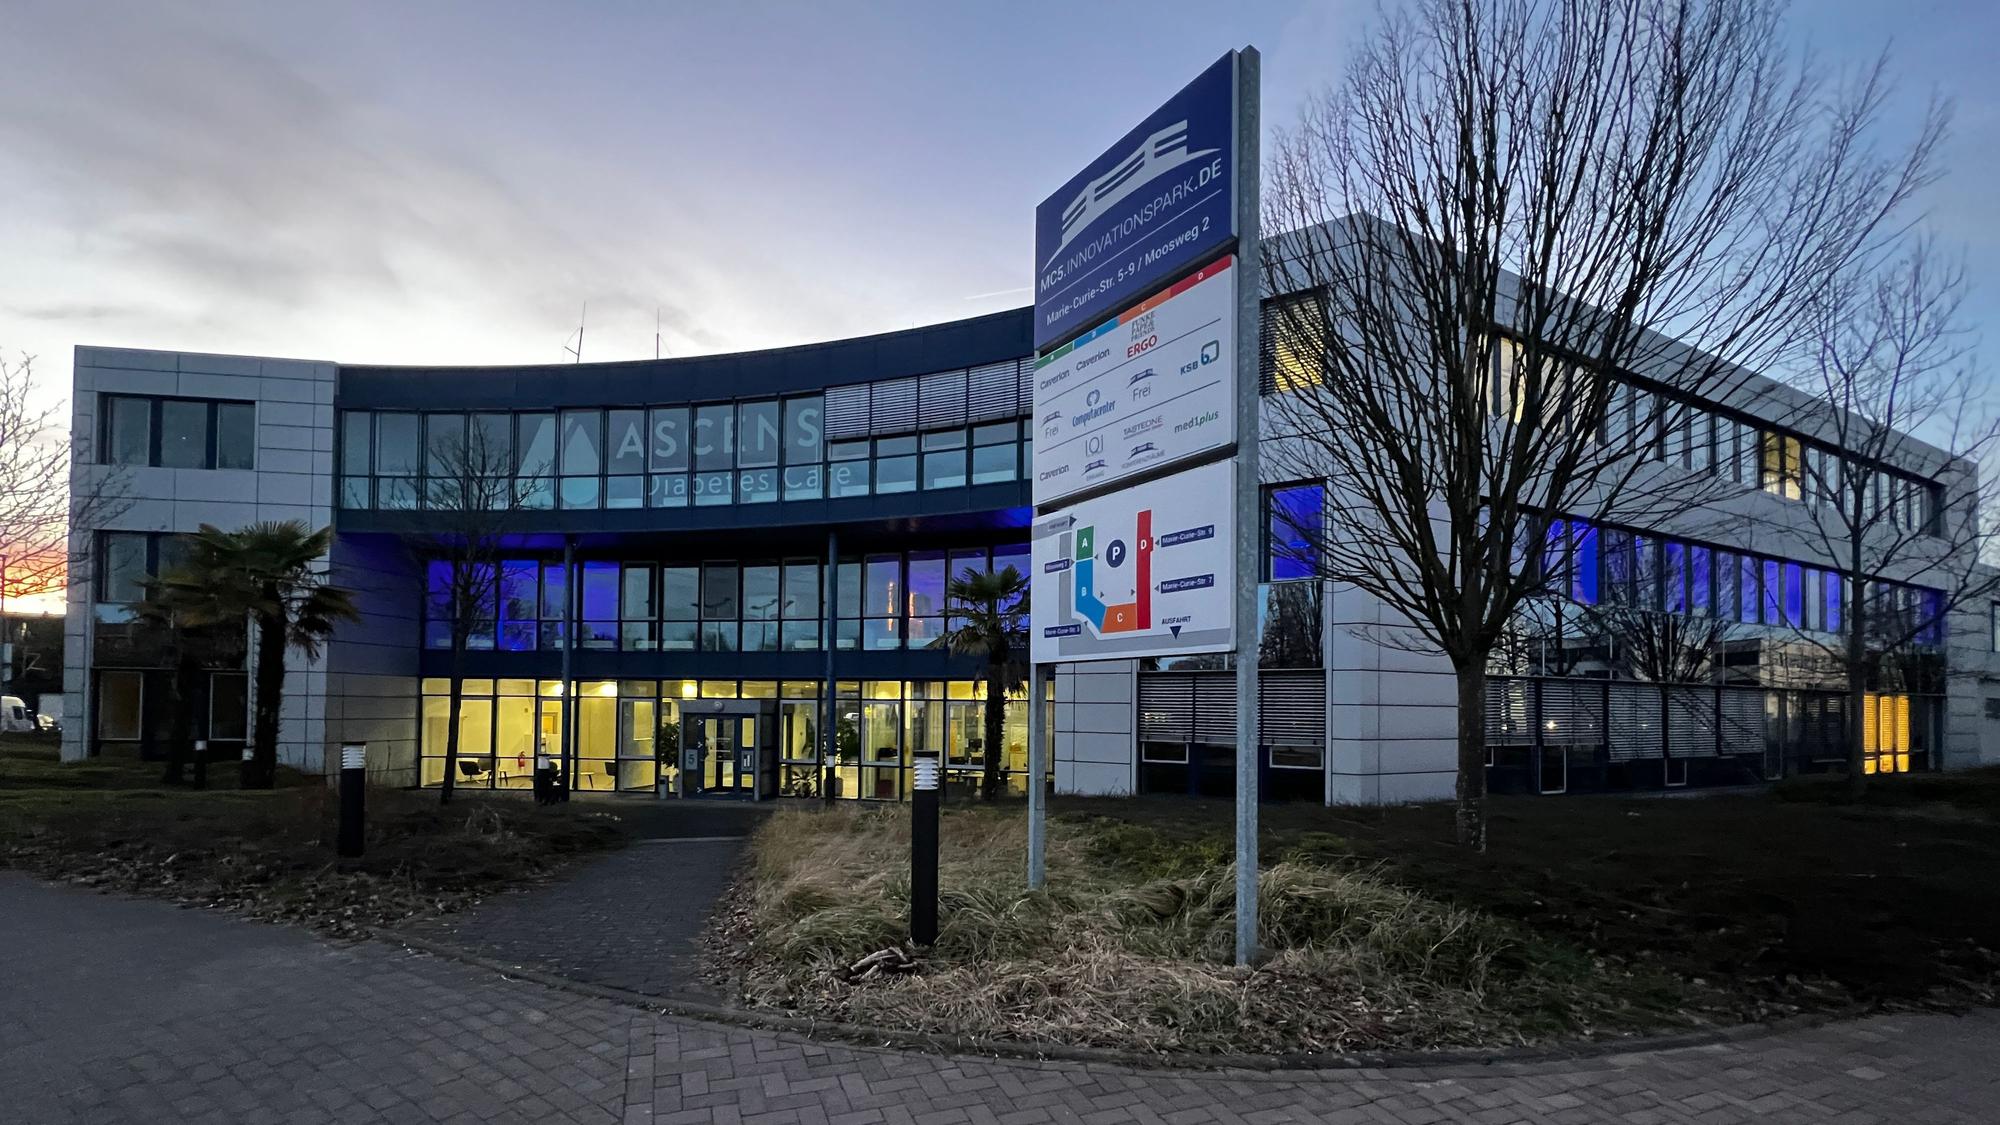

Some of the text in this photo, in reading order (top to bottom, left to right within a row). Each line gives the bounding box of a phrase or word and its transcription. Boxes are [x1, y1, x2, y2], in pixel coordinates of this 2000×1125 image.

[1040, 158, 1222, 293] MC5.INNOVATIONSPARK.DE
[1046, 279, 1115, 326] Marie-Curie-Str.
[1117, 261, 1135, 283] 5-9
[1144, 225, 1199, 267] Moosweg
[1201, 215, 1210, 232] 2
[1198, 272, 1204, 280] D
[1127, 334, 1157, 358] ERGO
[1076, 348, 1110, 371] Caverion
[1180, 360, 1198, 376] KSB
[1040, 369, 1070, 390] Caverion
[1132, 382, 1151, 402] Frei
[1174, 411, 1219, 434] med1plus
[1045, 426, 1059, 439] Frei
[784, 466, 851, 489] Cae
[1040, 464, 1069, 481] Caverion
[1081, 537, 1088, 549] A
[1140, 539, 1147, 549] D
[1112, 546, 1121, 560] P
[1081, 587, 1087, 597] B
[1116, 612, 1123, 622] C
[1161, 616, 1192, 625] AUSFAHRT
[688, 754, 695, 765] 5
